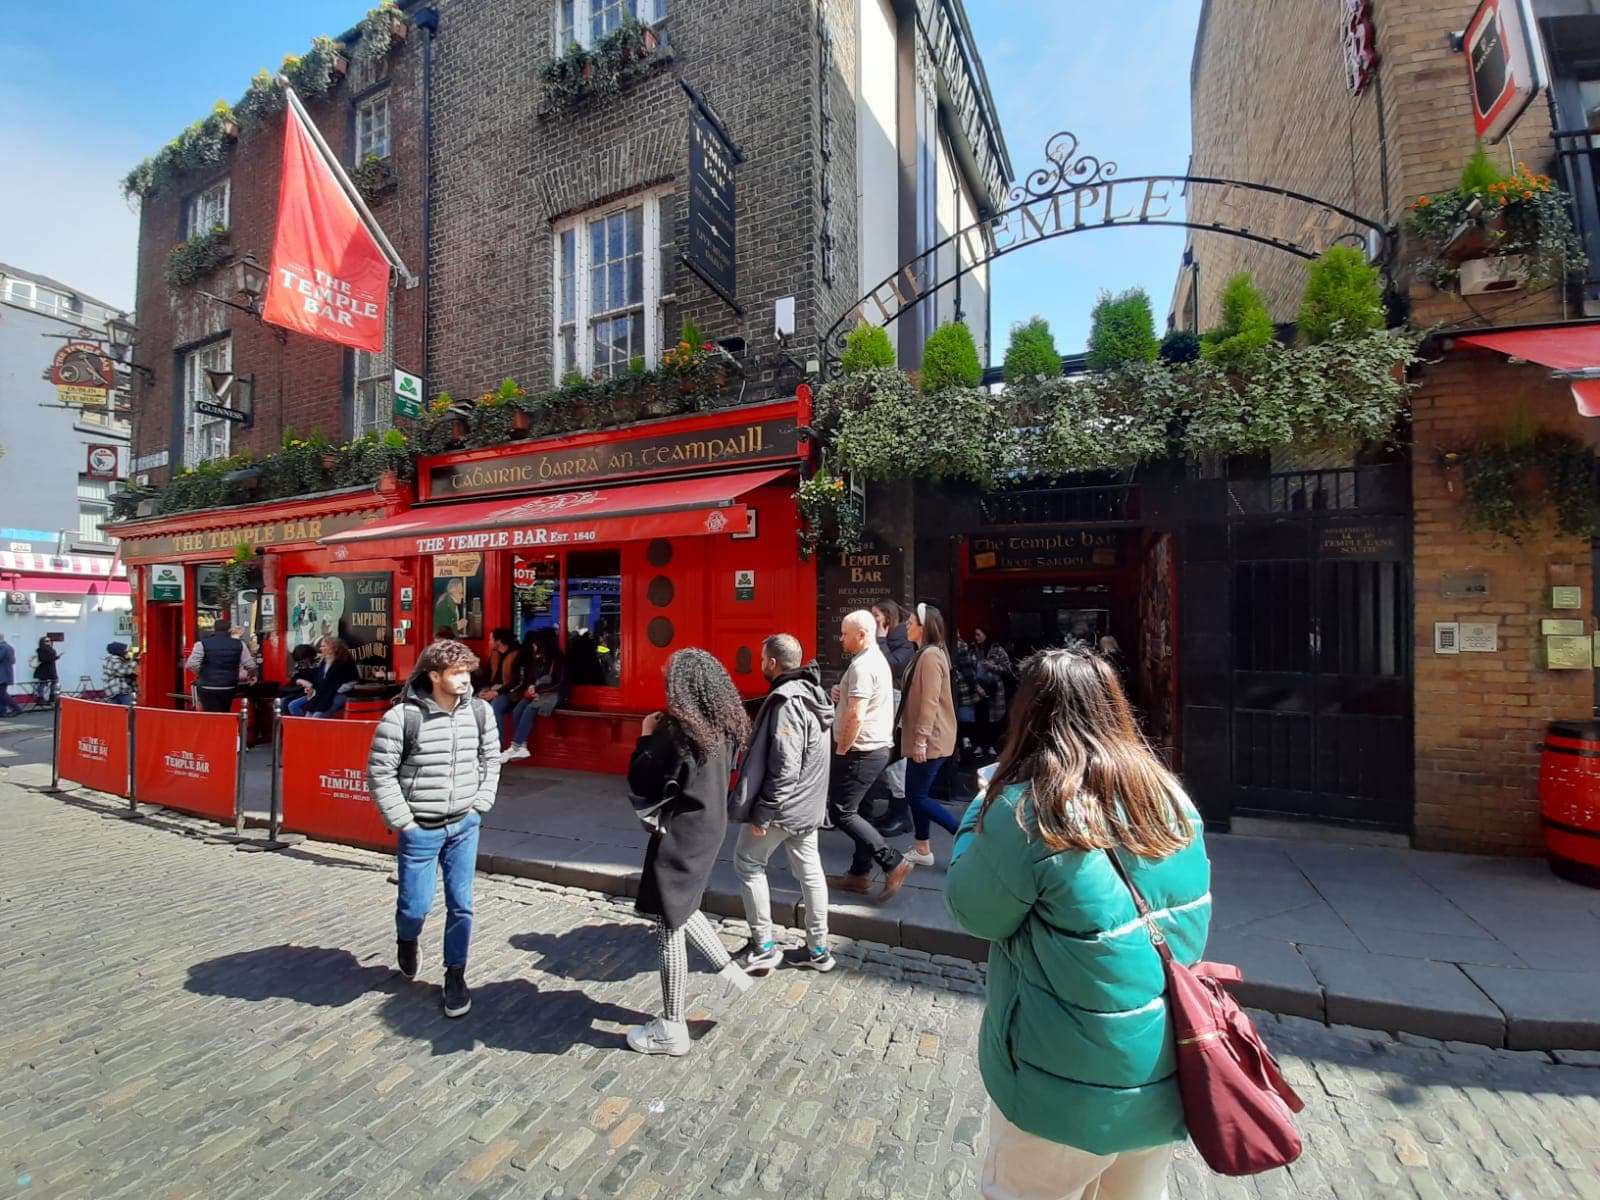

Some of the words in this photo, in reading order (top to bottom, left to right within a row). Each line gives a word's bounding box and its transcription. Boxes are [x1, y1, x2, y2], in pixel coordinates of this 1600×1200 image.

[957, 177, 1175, 266] TEMPLE
[314, 268, 352, 296] THE
[279, 268, 379, 319] TEMPLE
[303, 297, 354, 328] BAR
[199, 403, 244, 420] GUINNESS
[172, 534, 204, 552] THE
[207, 527, 274, 548] TEMPLE
[283, 520, 323, 540] BAR
[416, 539, 445, 553] THE
[448, 532, 509, 551] TEMPLE
[512, 528, 548, 546] BAR
[838, 551, 891, 567] TEMPLE
[851, 567, 882, 583] BAR
[859, 587, 892, 595] GARDEN
[181, 750, 194, 760] THE
[164, 755, 195, 770] TEMPLE
[196, 761, 209, 773] BAR
[344, 768, 362, 779] THE
[319, 775, 362, 791] TEMPLE
